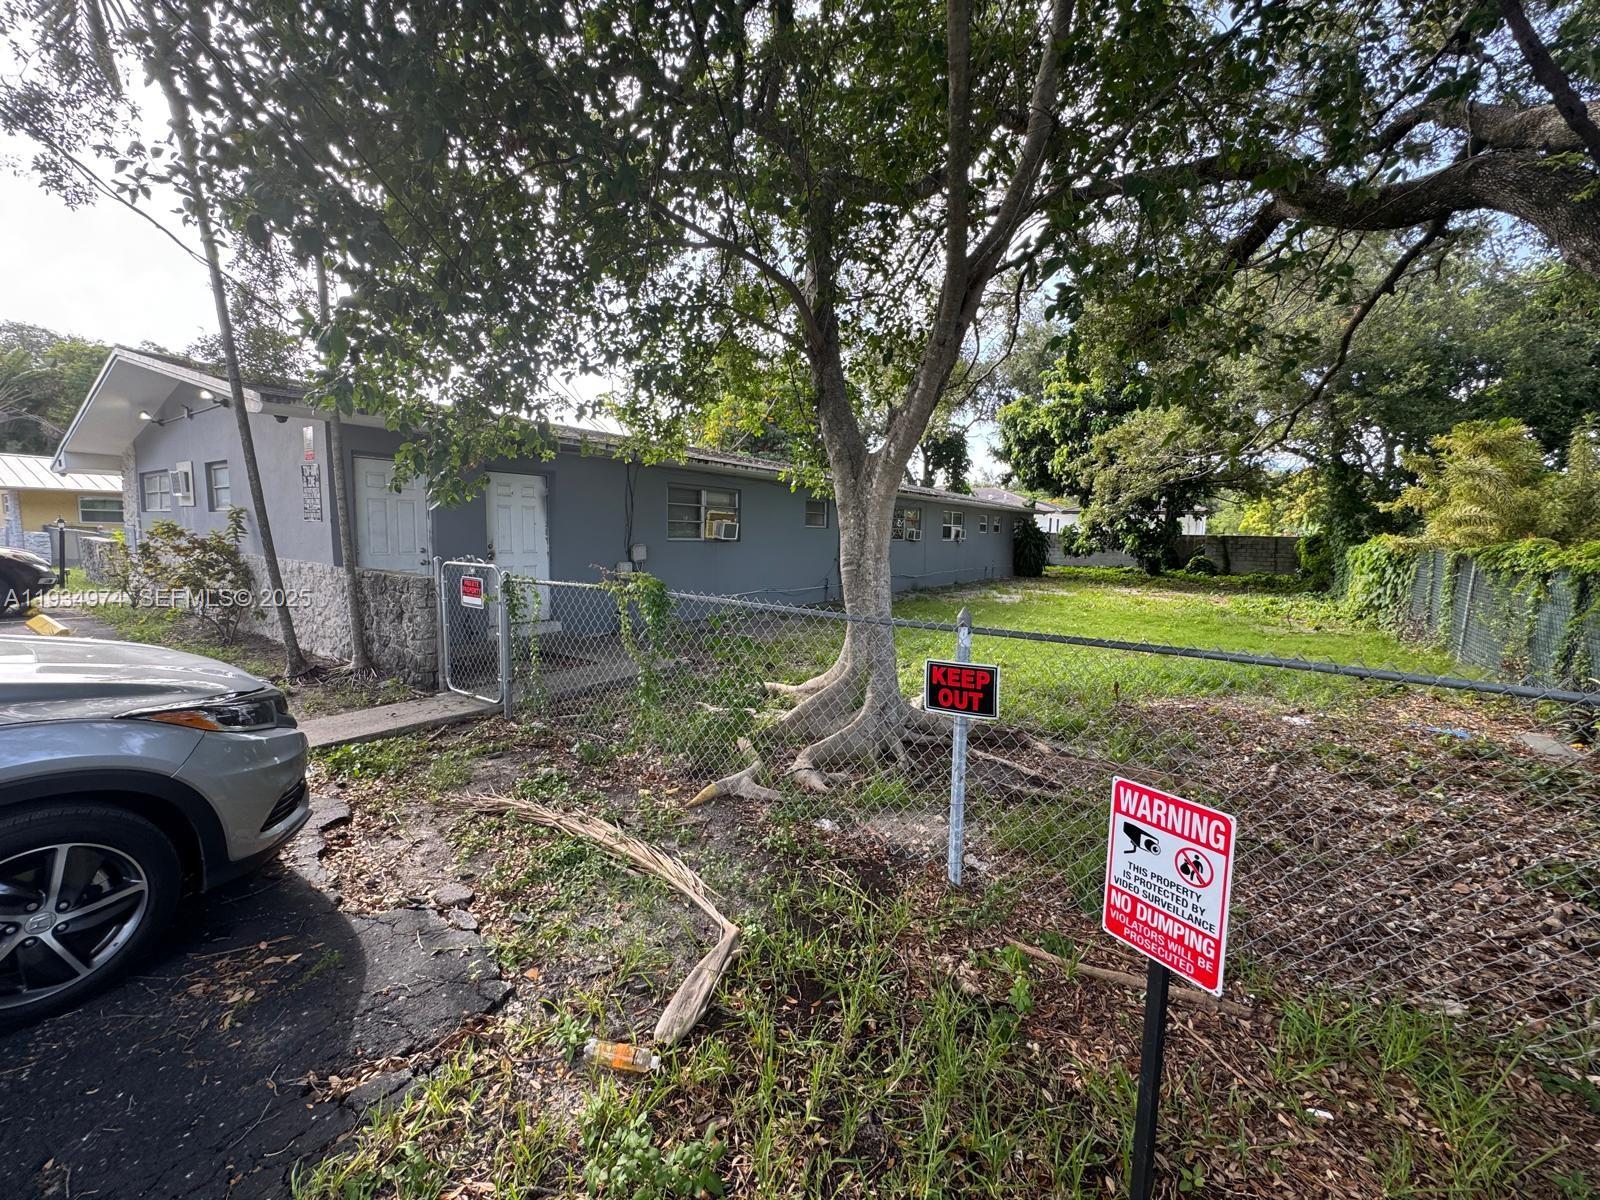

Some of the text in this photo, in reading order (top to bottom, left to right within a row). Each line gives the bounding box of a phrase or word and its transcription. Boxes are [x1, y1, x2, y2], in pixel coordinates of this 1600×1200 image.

[932, 665, 990, 690] KEEP
[938, 688, 983, 711] OUT
[1119, 786, 1226, 851] WARNING
[1114, 875, 1216, 935] VIDEO SURVEILLANCE
[1123, 869, 1206, 917] IS PROTECTED BY
[1128, 861, 1202, 903] THIS PROPERTY
[1110, 888, 1215, 960] NO DUMPING
[1110, 908, 1213, 974] VIOLATORS WILL BE
[1123, 927, 1195, 975] PROSECUTED
